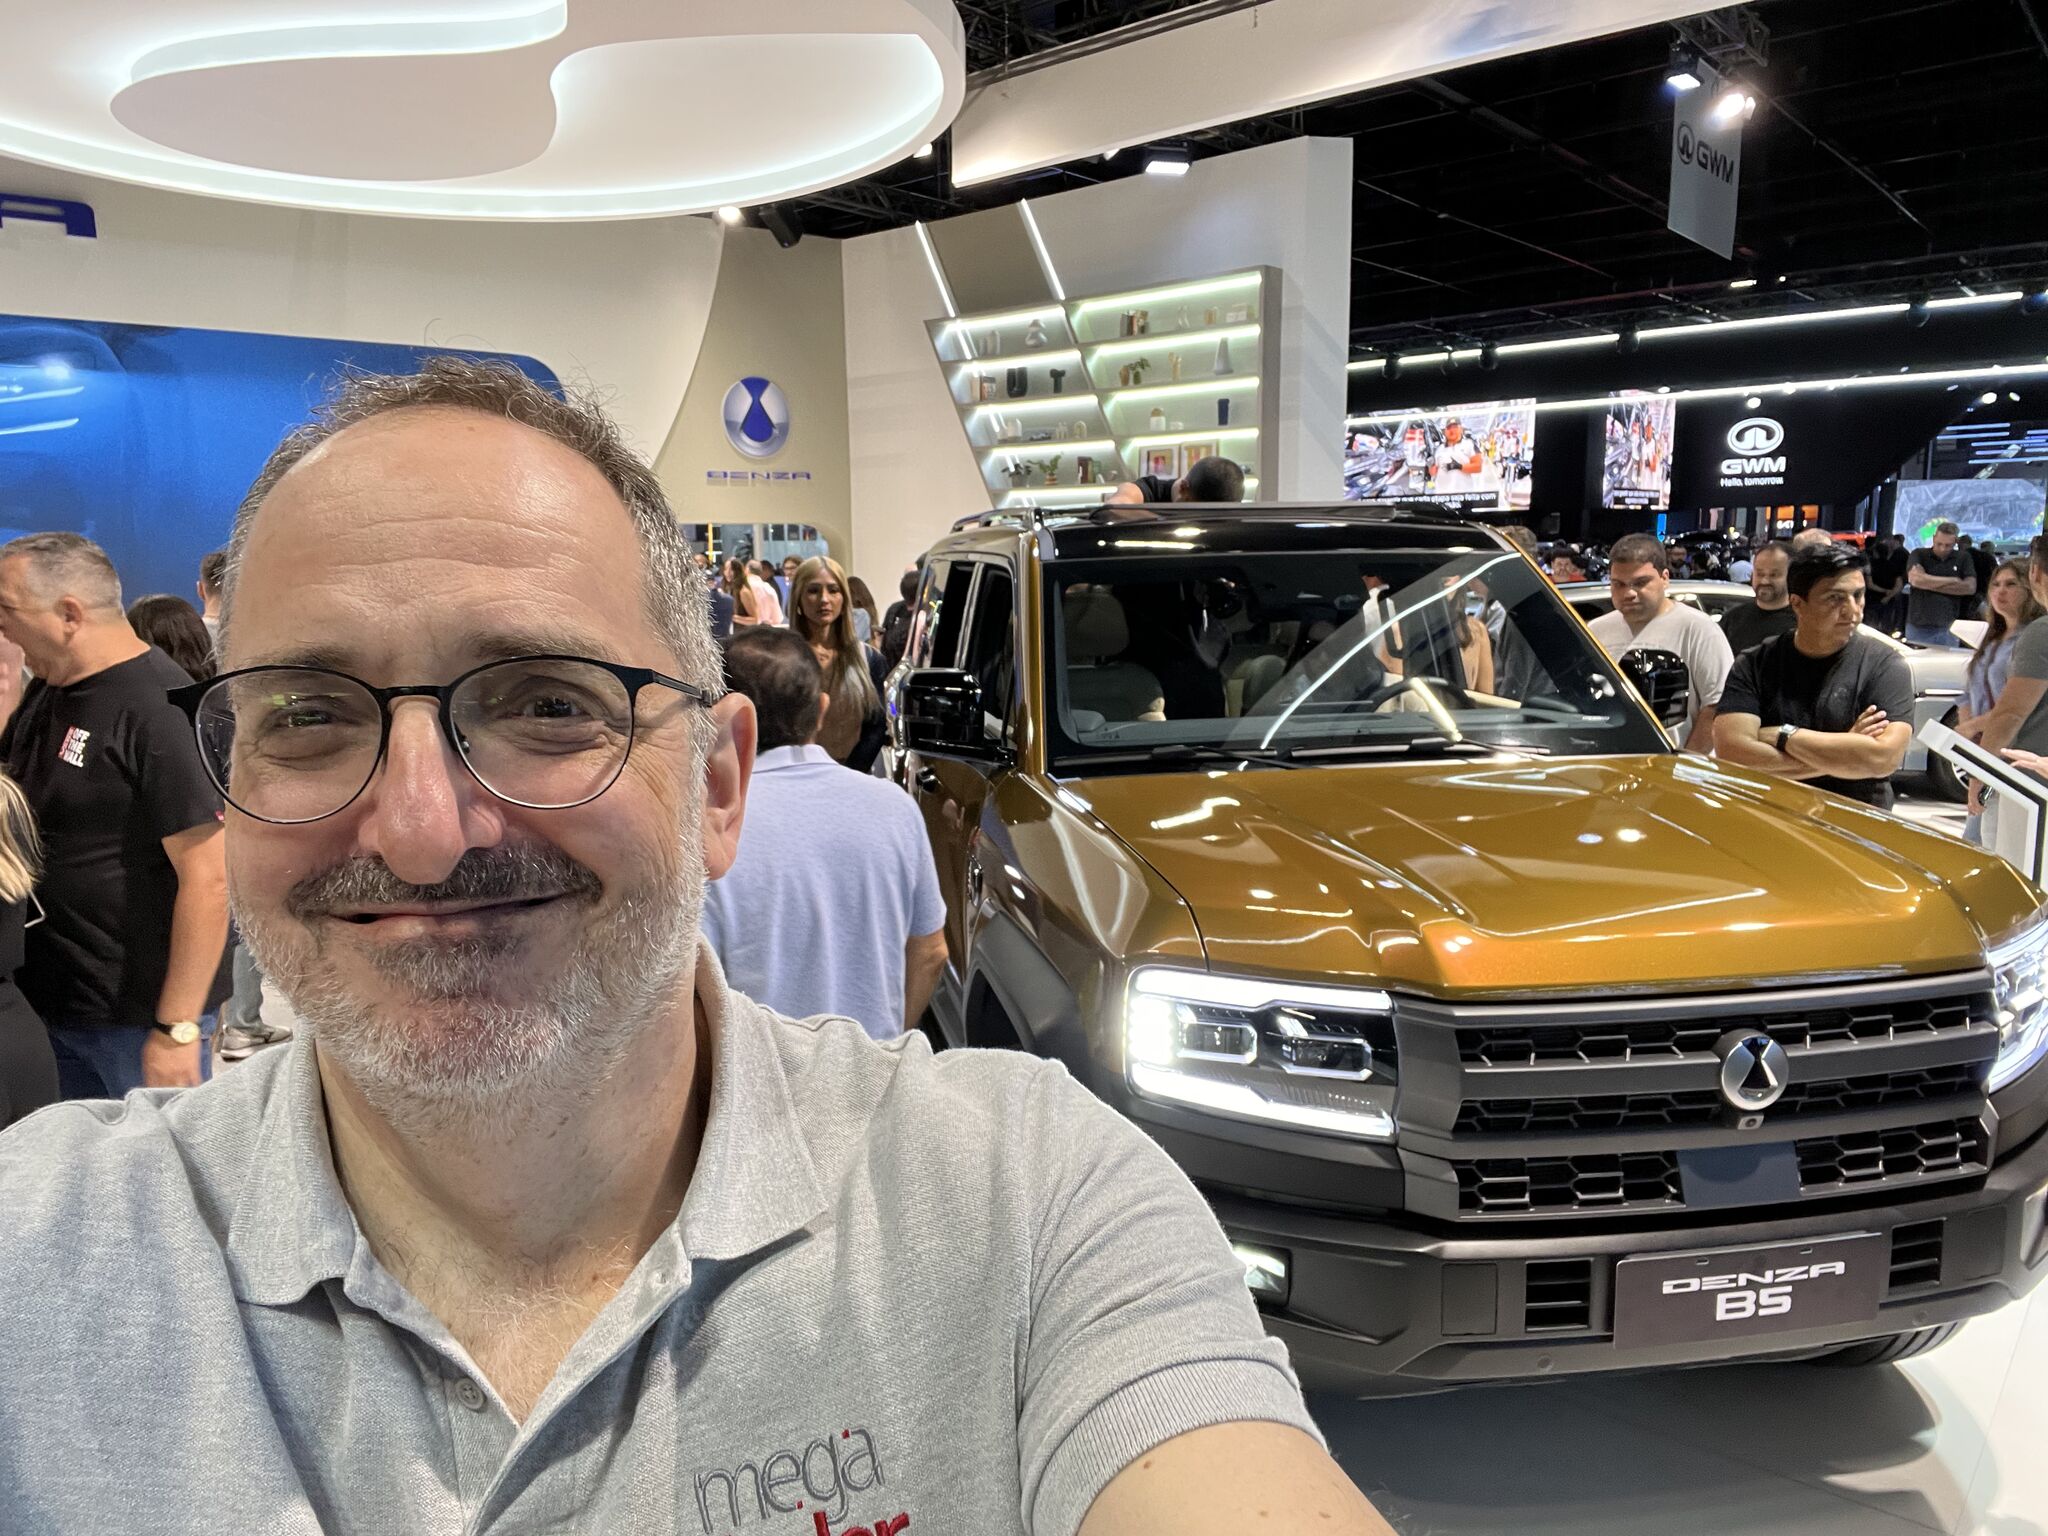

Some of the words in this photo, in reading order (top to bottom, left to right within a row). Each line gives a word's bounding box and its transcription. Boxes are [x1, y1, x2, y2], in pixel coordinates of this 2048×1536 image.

[1696, 140, 1734, 185] GWM
[706, 471, 811, 480] DENZA
[1721, 456, 1786, 474] GWM
[67, 739, 85, 755] THE
[72, 727, 90, 743] OFF
[1662, 1261, 1846, 1295] DENZA
[1716, 1285, 1793, 1321] B5
[694, 1428, 885, 1534] mega
